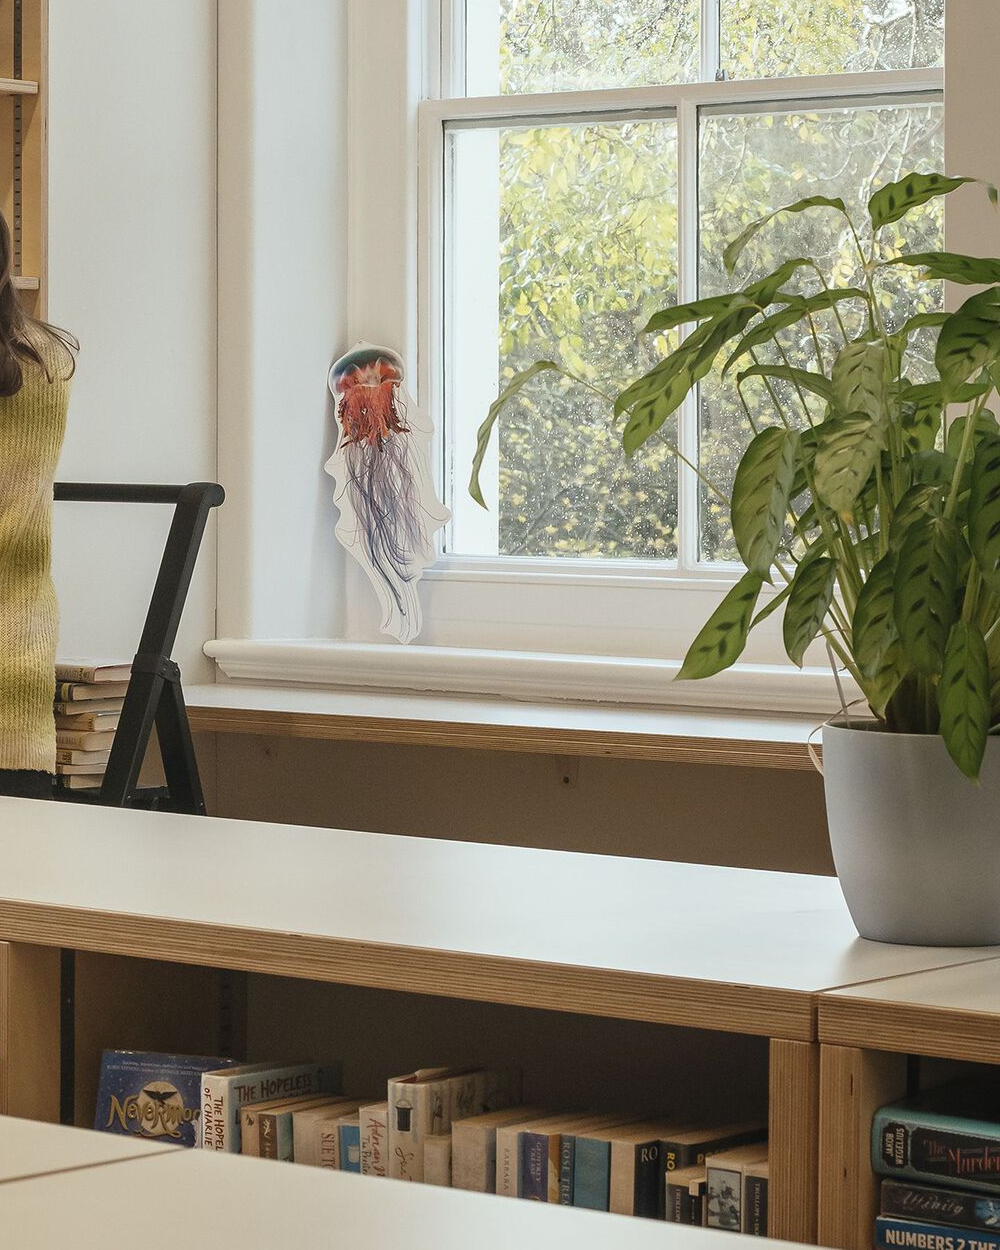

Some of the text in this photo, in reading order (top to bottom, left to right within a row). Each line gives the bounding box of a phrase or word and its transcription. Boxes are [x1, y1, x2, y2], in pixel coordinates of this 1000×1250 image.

[233, 1084, 257, 1103] THE
[203, 1087, 213, 1147] OF CHARLIE
[213, 1095, 225, 1151] THE HOPEL
[320, 1132, 336, 1156] SUE
[640, 1146, 659, 1163] RO
[885, 1133, 895, 1158] JAKOB
[894, 1127, 905, 1166] WEGELIUS
[923, 1139, 948, 1157] The
[561, 1141, 571, 1173] ROSE
[666, 1152, 676, 1171] RO
[885, 1229, 954, 1250] NUMBERS
